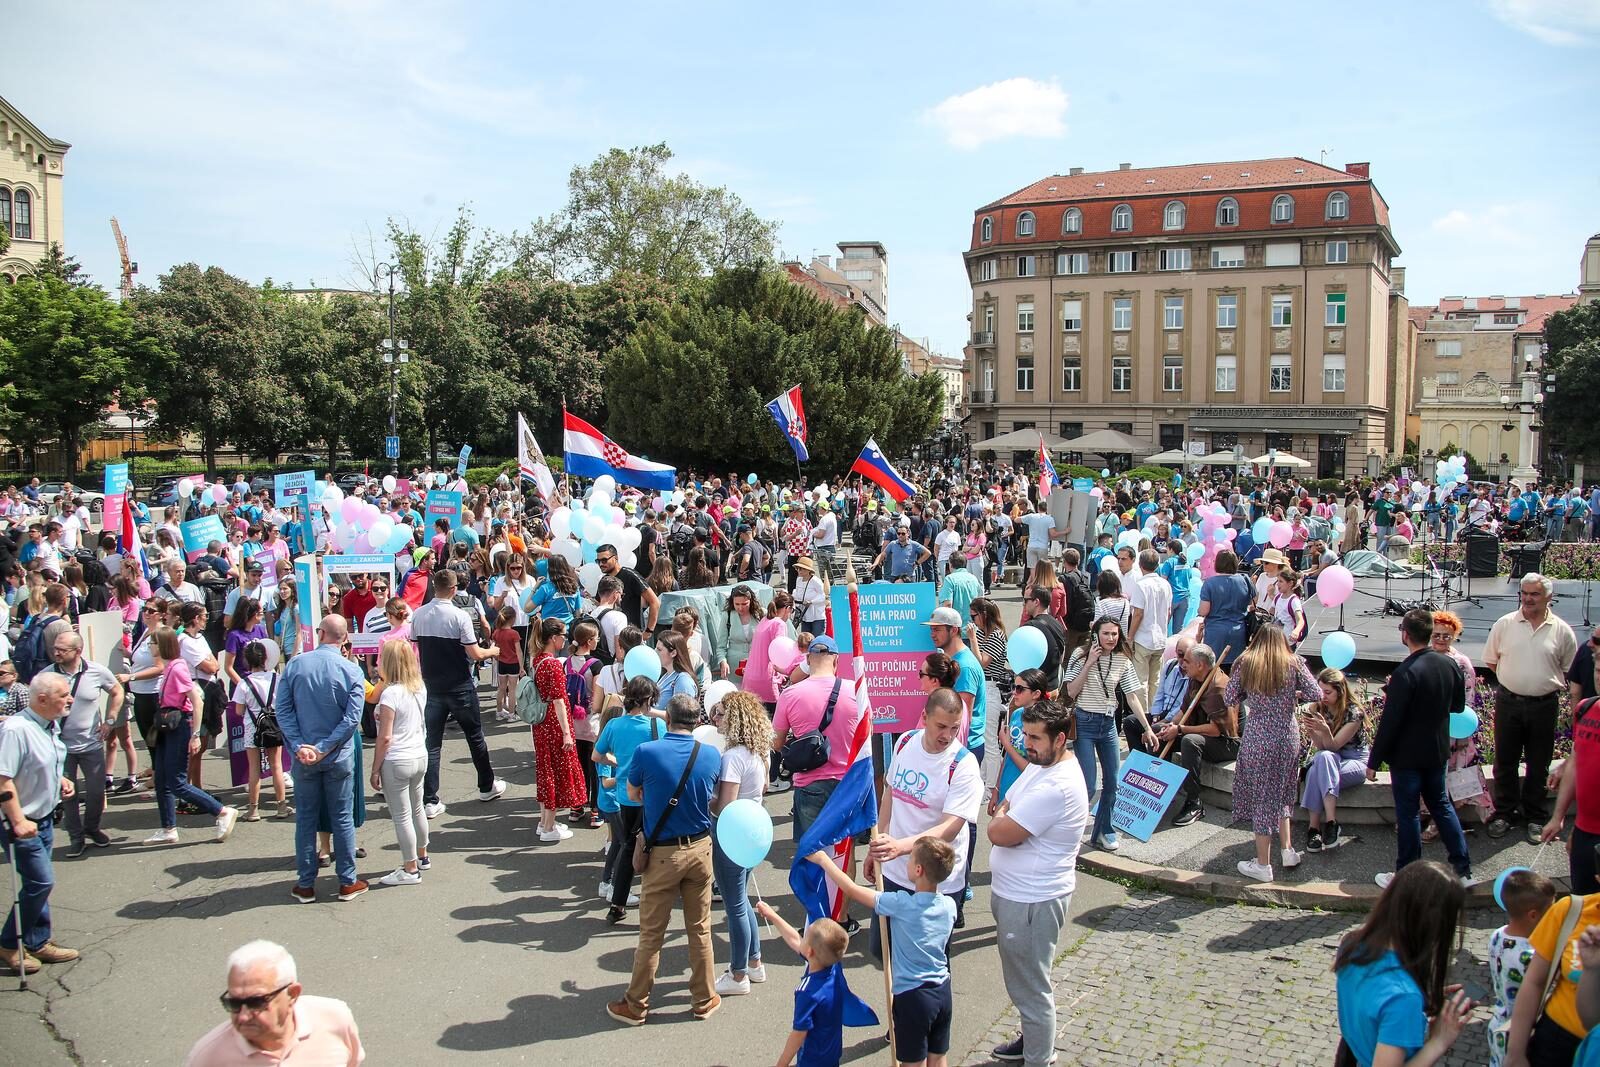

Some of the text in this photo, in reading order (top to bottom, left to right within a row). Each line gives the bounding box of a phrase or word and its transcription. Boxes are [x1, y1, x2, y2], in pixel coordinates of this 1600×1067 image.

[1195, 408, 1265, 417] HEMINGWAY
[1271, 409, 1292, 417] BAR
[1309, 409, 1357, 418] BISTROT
[879, 593, 916, 605] LJUDSKO
[870, 610, 886, 621] IMA
[888, 609, 917, 620] PRAVO
[861, 626, 874, 637] NA
[881, 659, 918, 672] POČINJE
[895, 764, 929, 792] HOD
